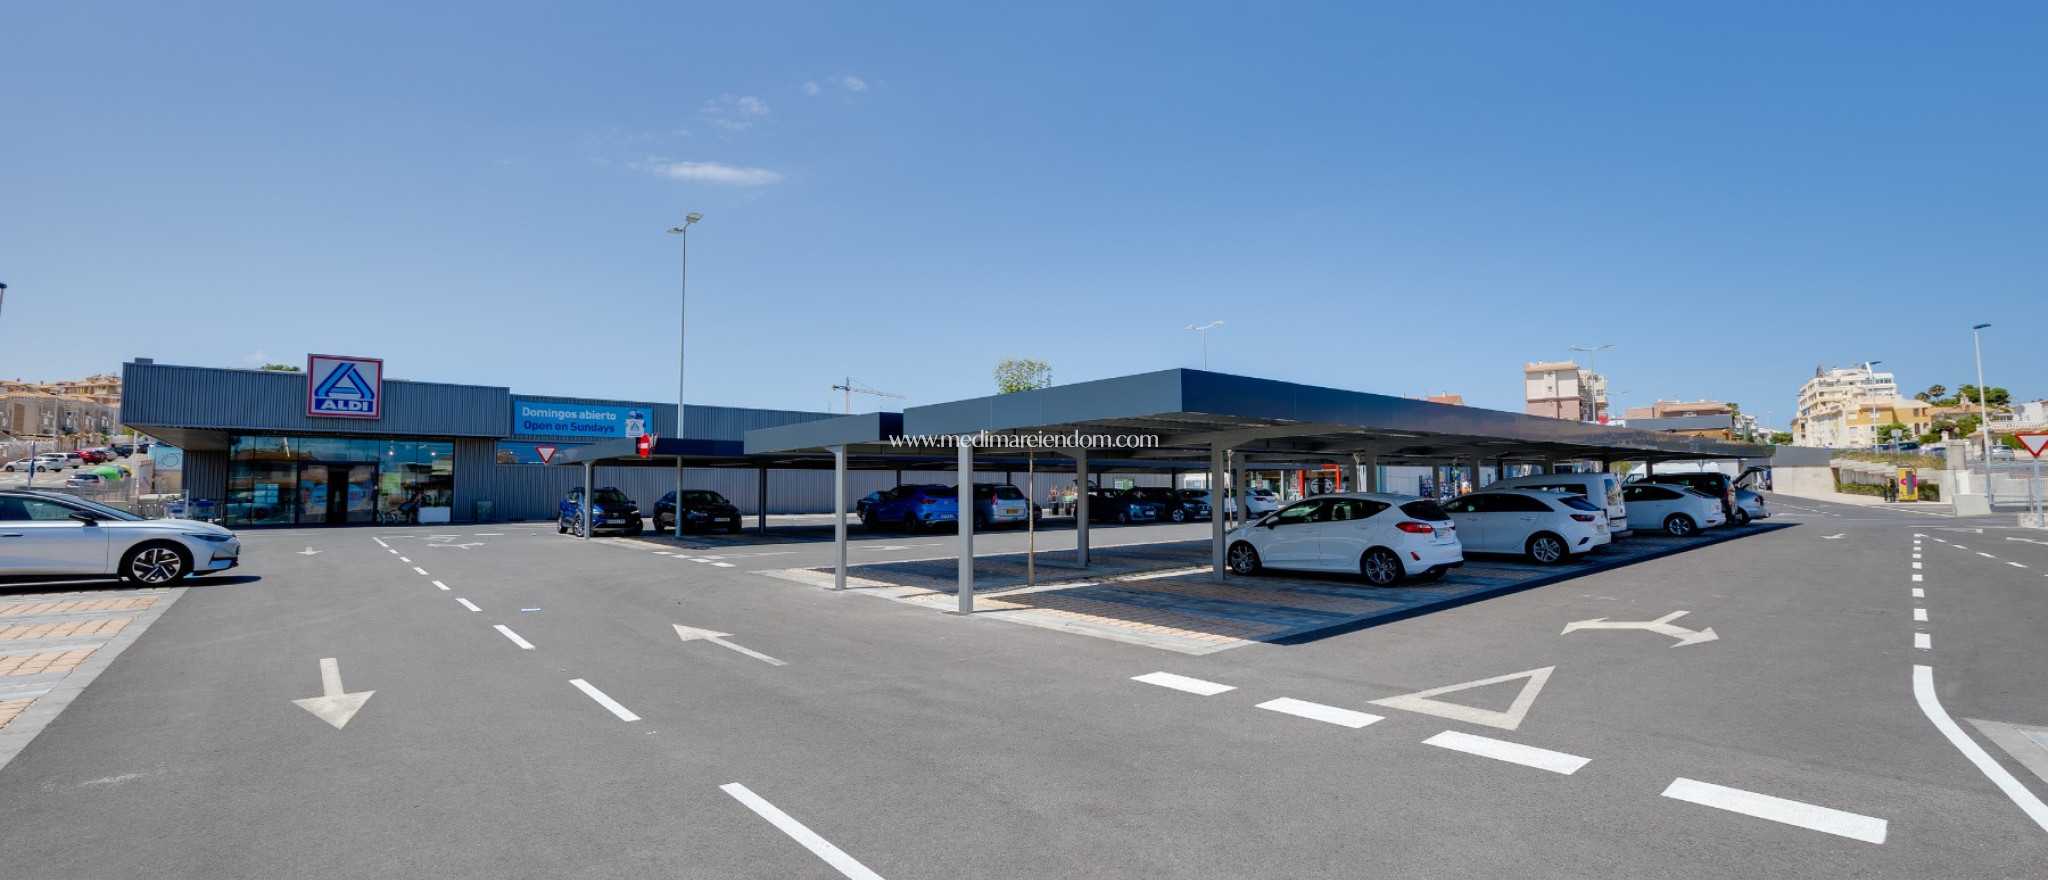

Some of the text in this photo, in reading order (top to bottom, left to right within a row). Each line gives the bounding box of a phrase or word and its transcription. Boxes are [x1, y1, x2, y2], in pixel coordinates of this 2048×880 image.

[320, 399, 369, 411] ALDI
[522, 407, 617, 421] Domingos abierto
[524, 420, 552, 431] Open
[571, 422, 615, 433] Sundays
